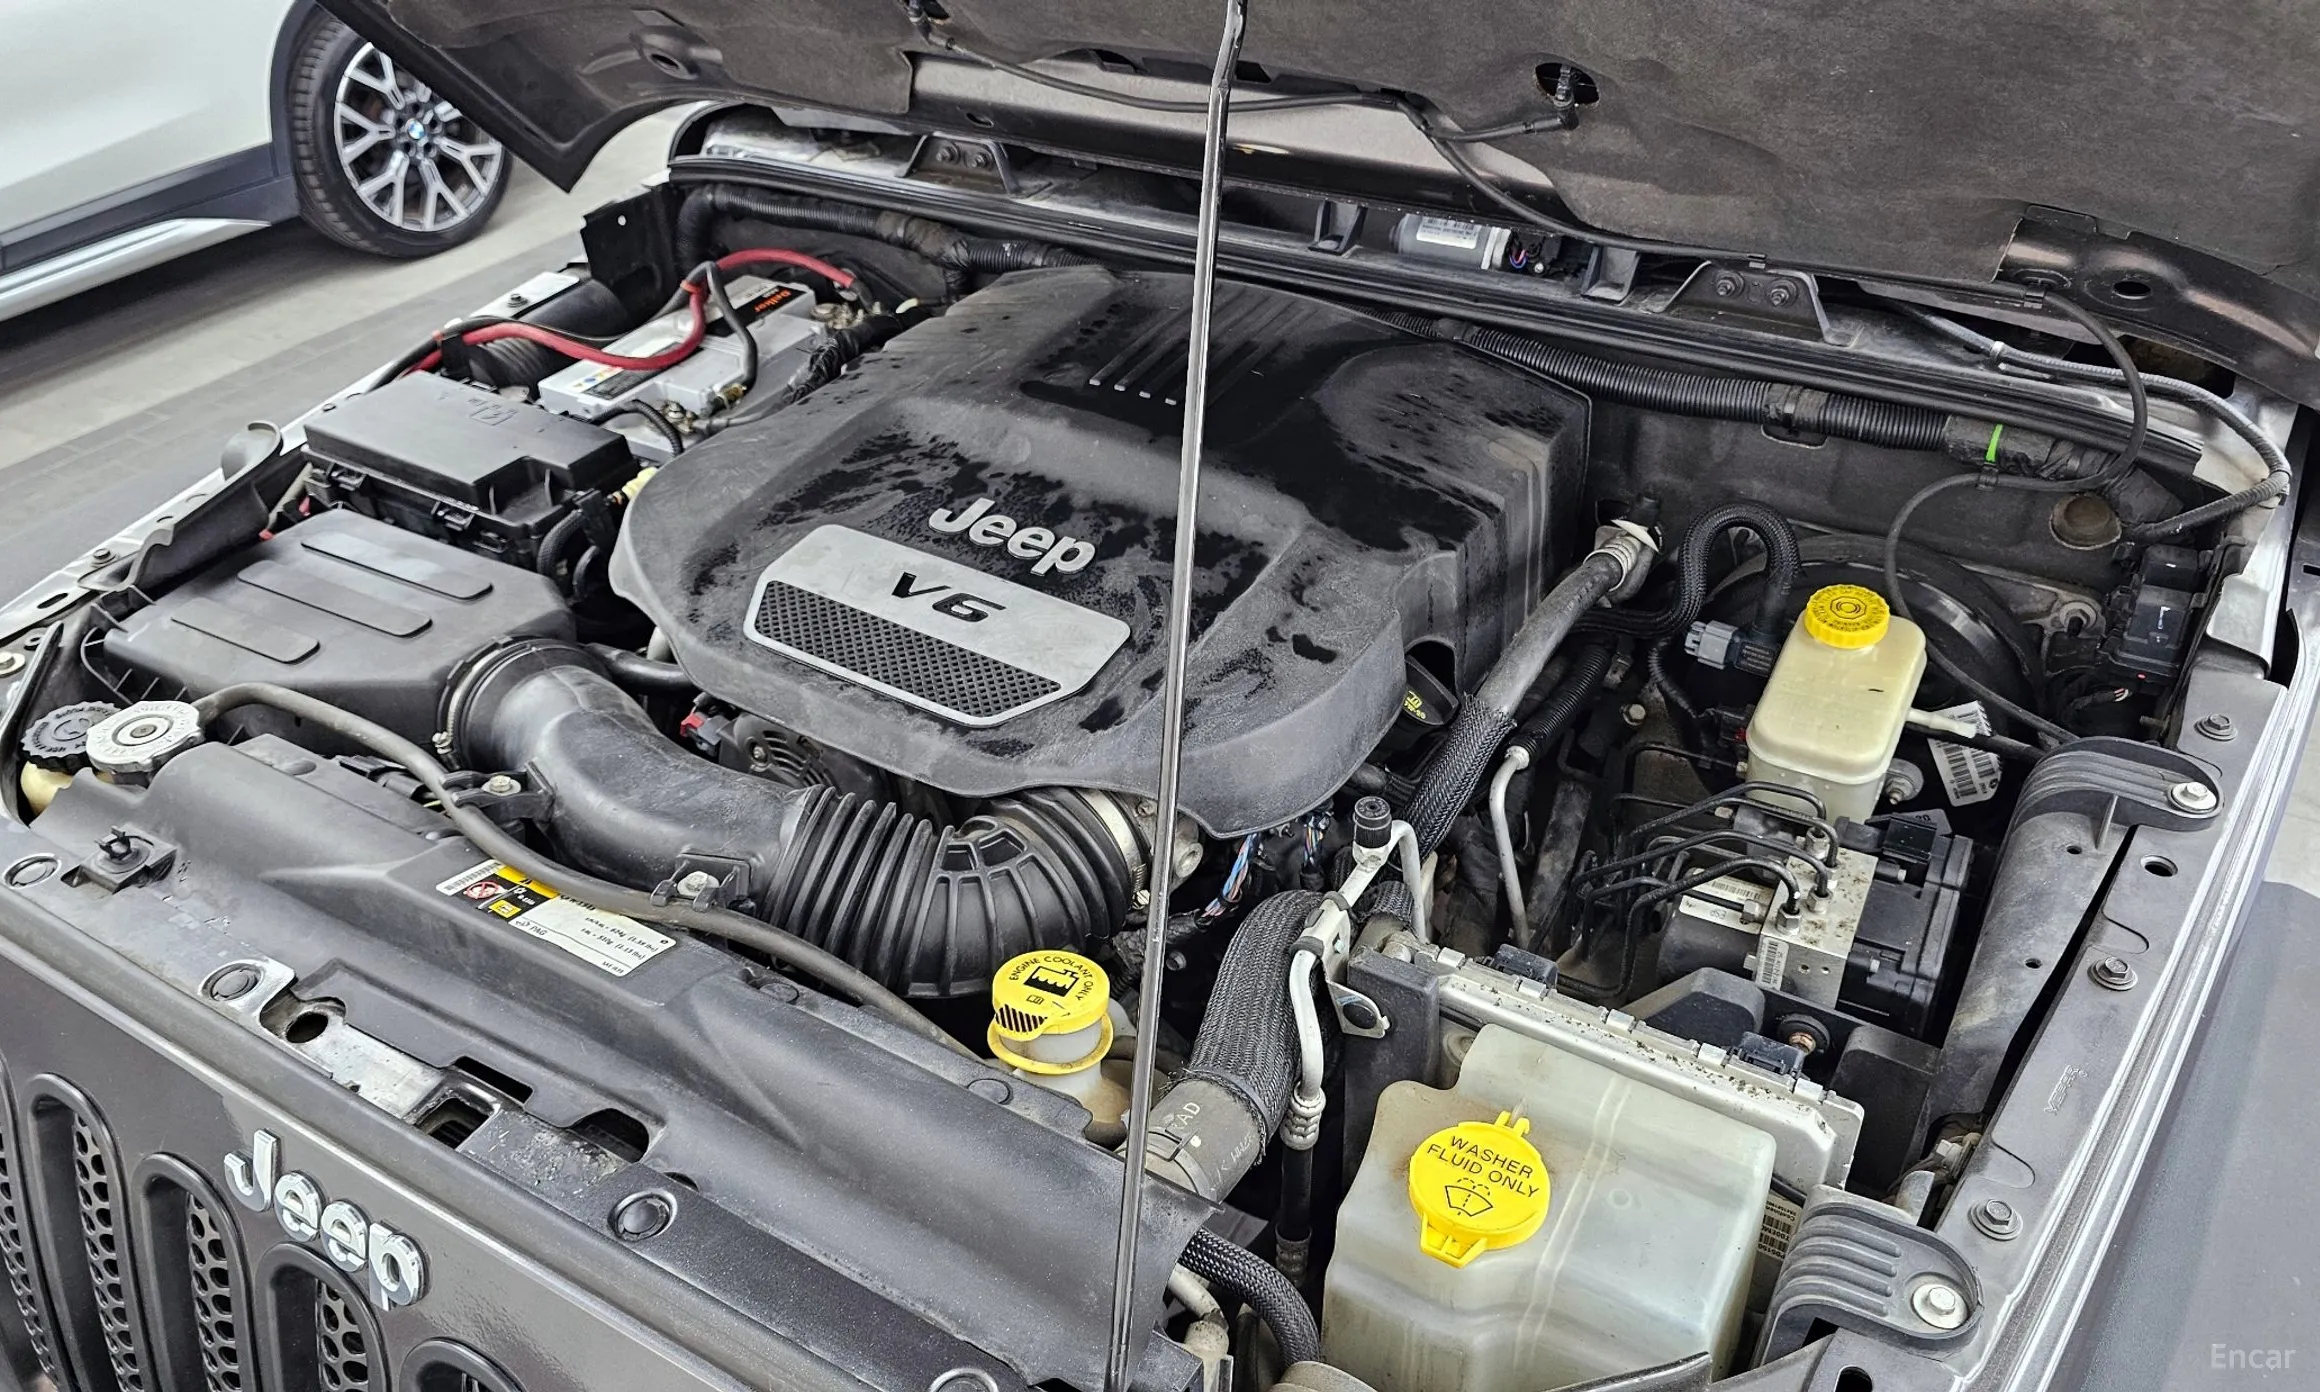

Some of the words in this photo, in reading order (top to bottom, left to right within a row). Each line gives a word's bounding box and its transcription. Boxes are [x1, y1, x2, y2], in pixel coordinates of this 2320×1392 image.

[928, 497, 1096, 576] Jeep
[891, 571, 1007, 622] V6
[530, 925, 548, 936] PAG
[1009, 957, 1041, 981] ENGINE
[1044, 955, 1093, 979] COOLANT
[1075, 981, 1095, 1001] ONLY
[1427, 1143, 1483, 1174] FLUID
[1488, 1170, 1540, 1198] ONLY
[1451, 1135, 1534, 1179] WASHER
[224, 1128, 430, 1311] Jeep
